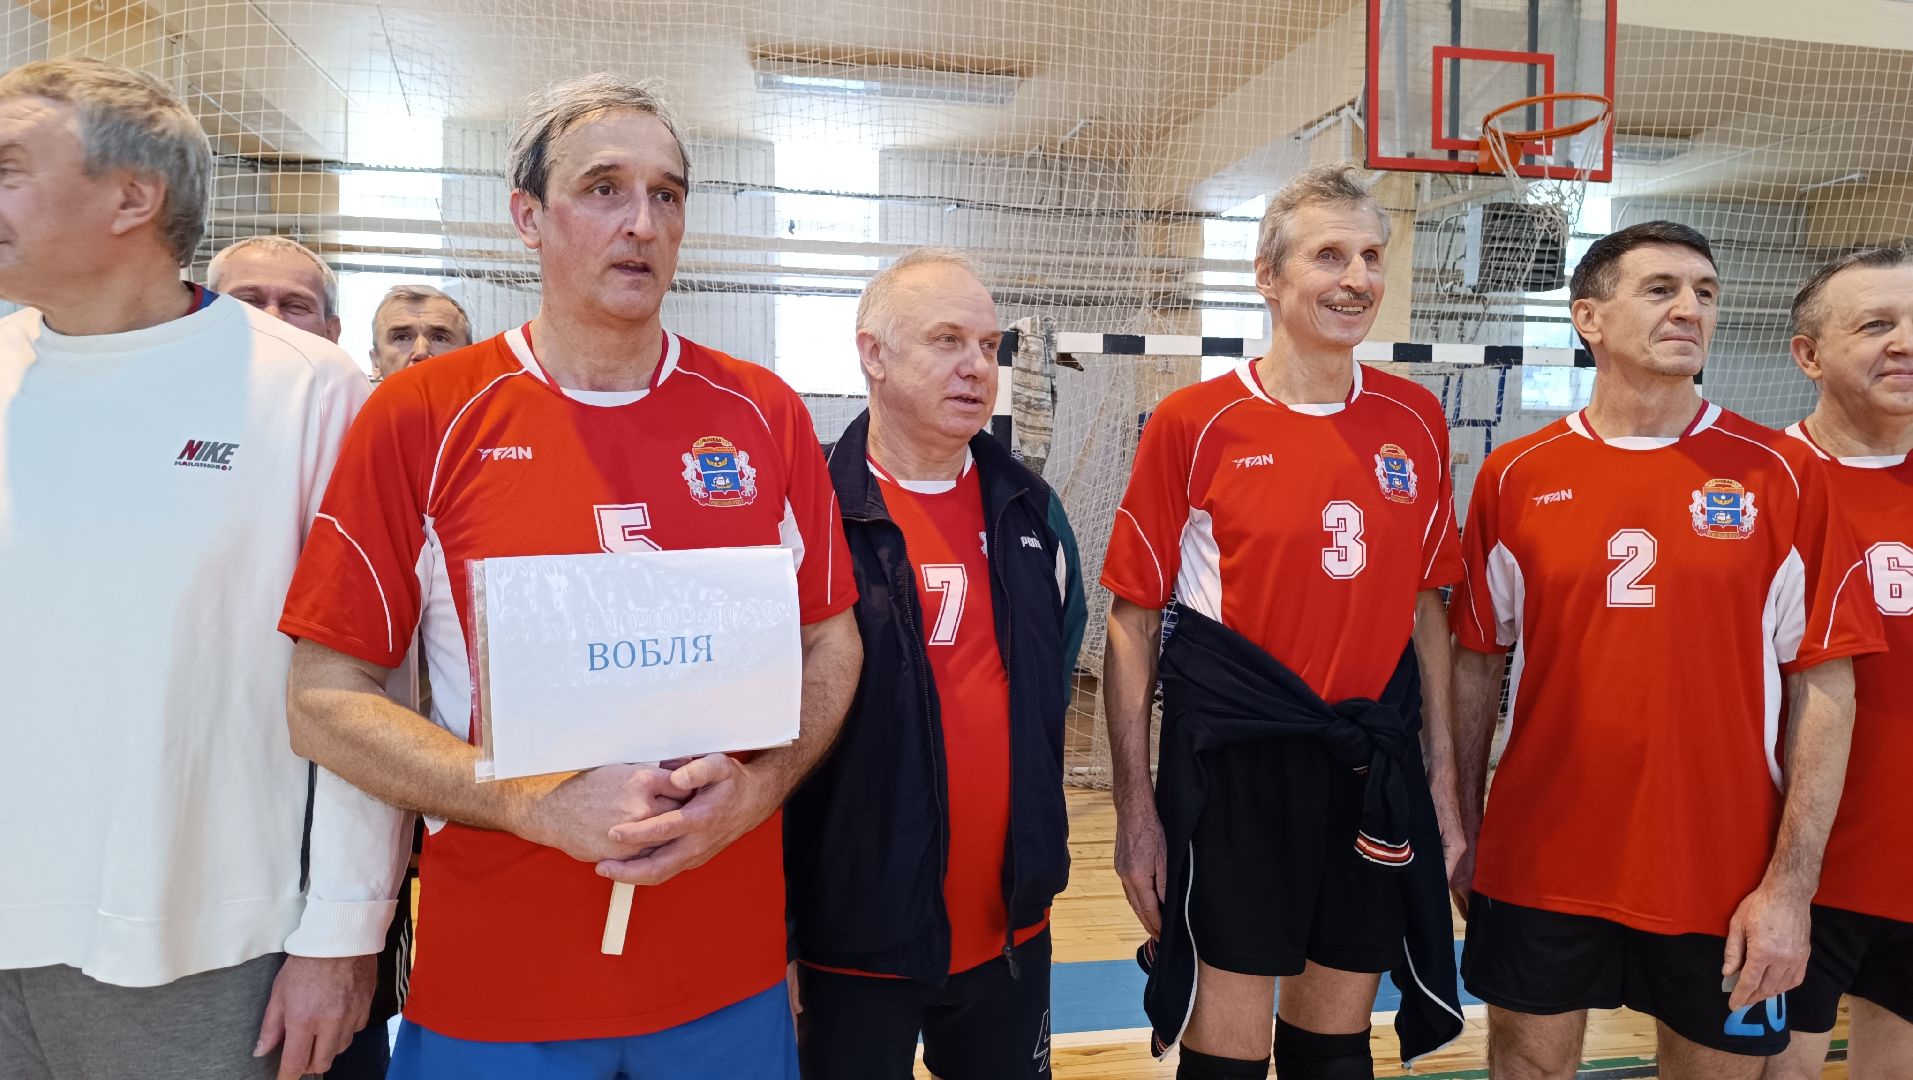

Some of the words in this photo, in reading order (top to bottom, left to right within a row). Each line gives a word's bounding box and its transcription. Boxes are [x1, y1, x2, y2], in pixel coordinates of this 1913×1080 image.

[176, 439, 240, 465] NIKE
[1321, 500, 1367, 579] 3
[1606, 528, 1658, 608] 2
[920, 563, 969, 646] 7
[1864, 541, 1913, 616] 6
[587, 634, 714, 672] ВОБЛЯ
